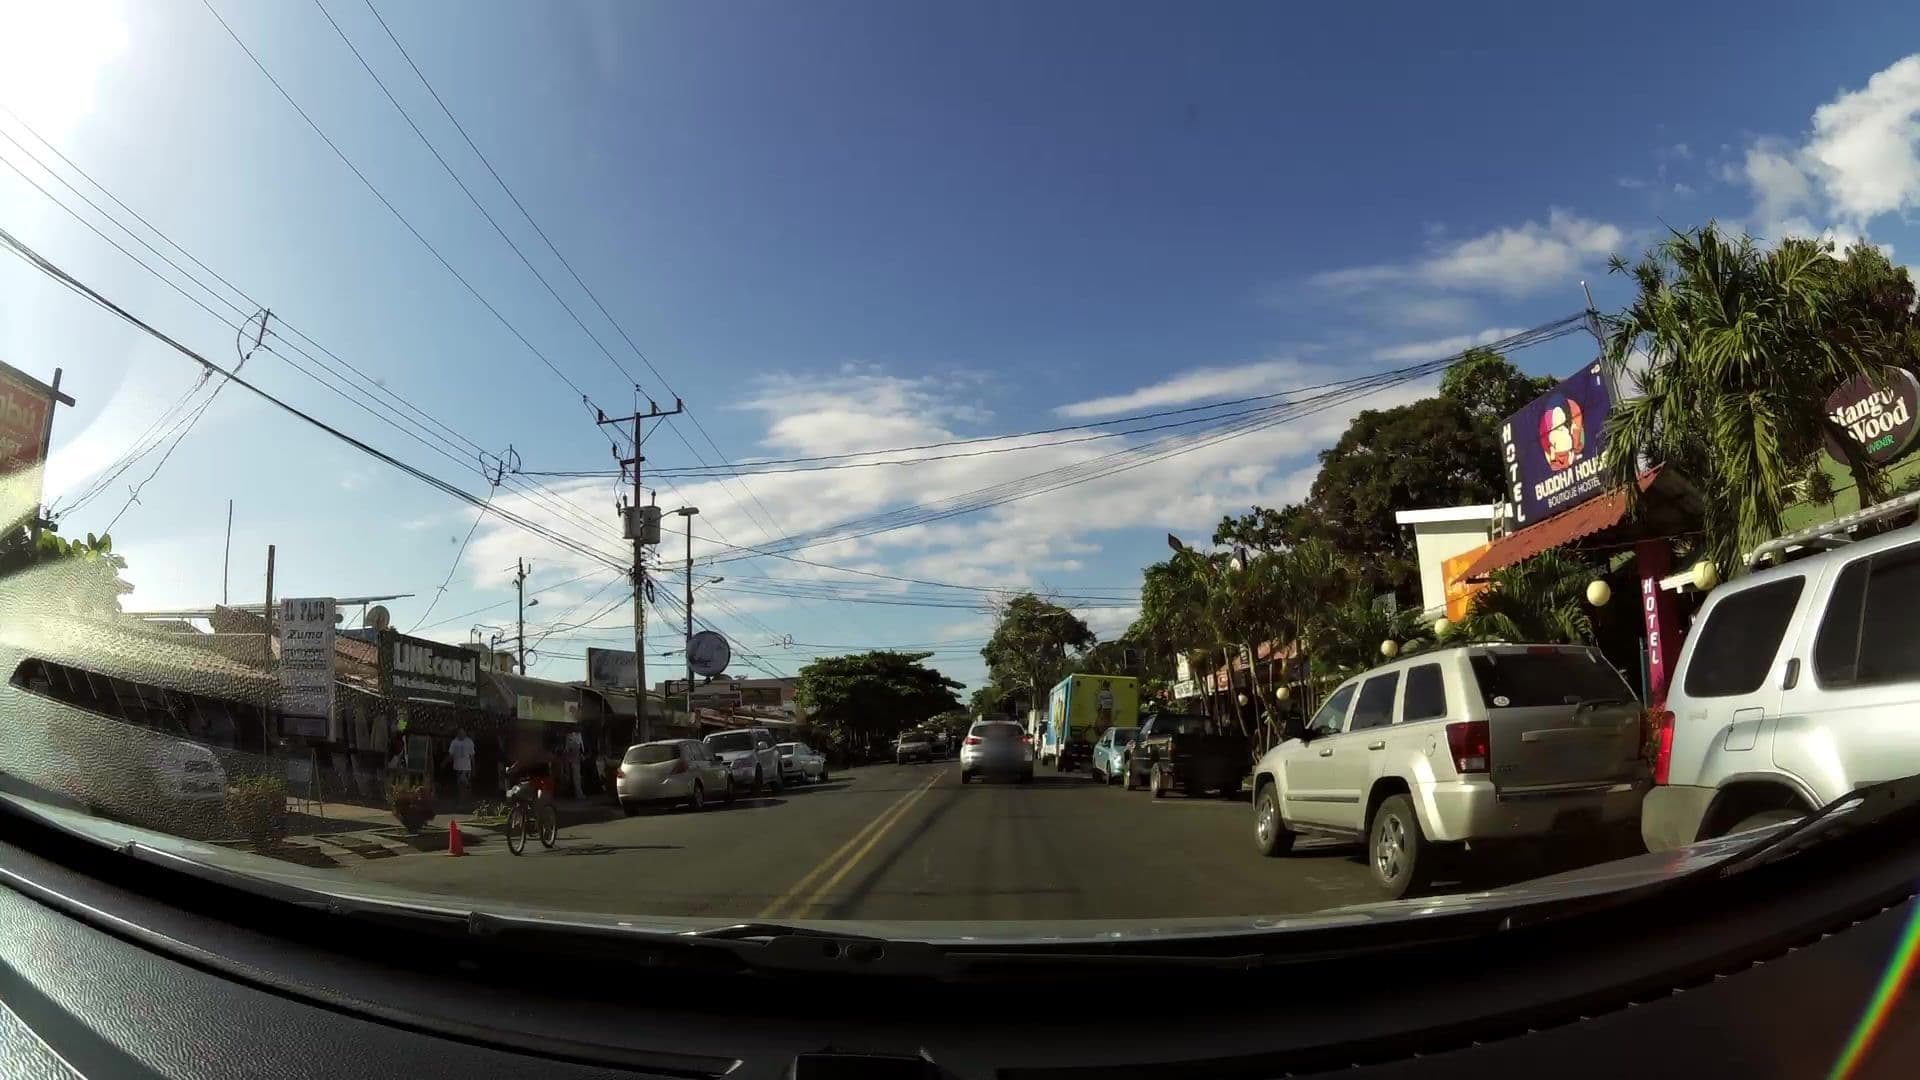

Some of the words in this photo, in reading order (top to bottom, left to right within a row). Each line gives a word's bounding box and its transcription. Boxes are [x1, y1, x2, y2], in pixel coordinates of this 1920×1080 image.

[1502, 422, 1526, 523] HOTEL
[1534, 467, 1575, 501] BUDDHA
[1643, 577, 1660, 665] HOTEL
